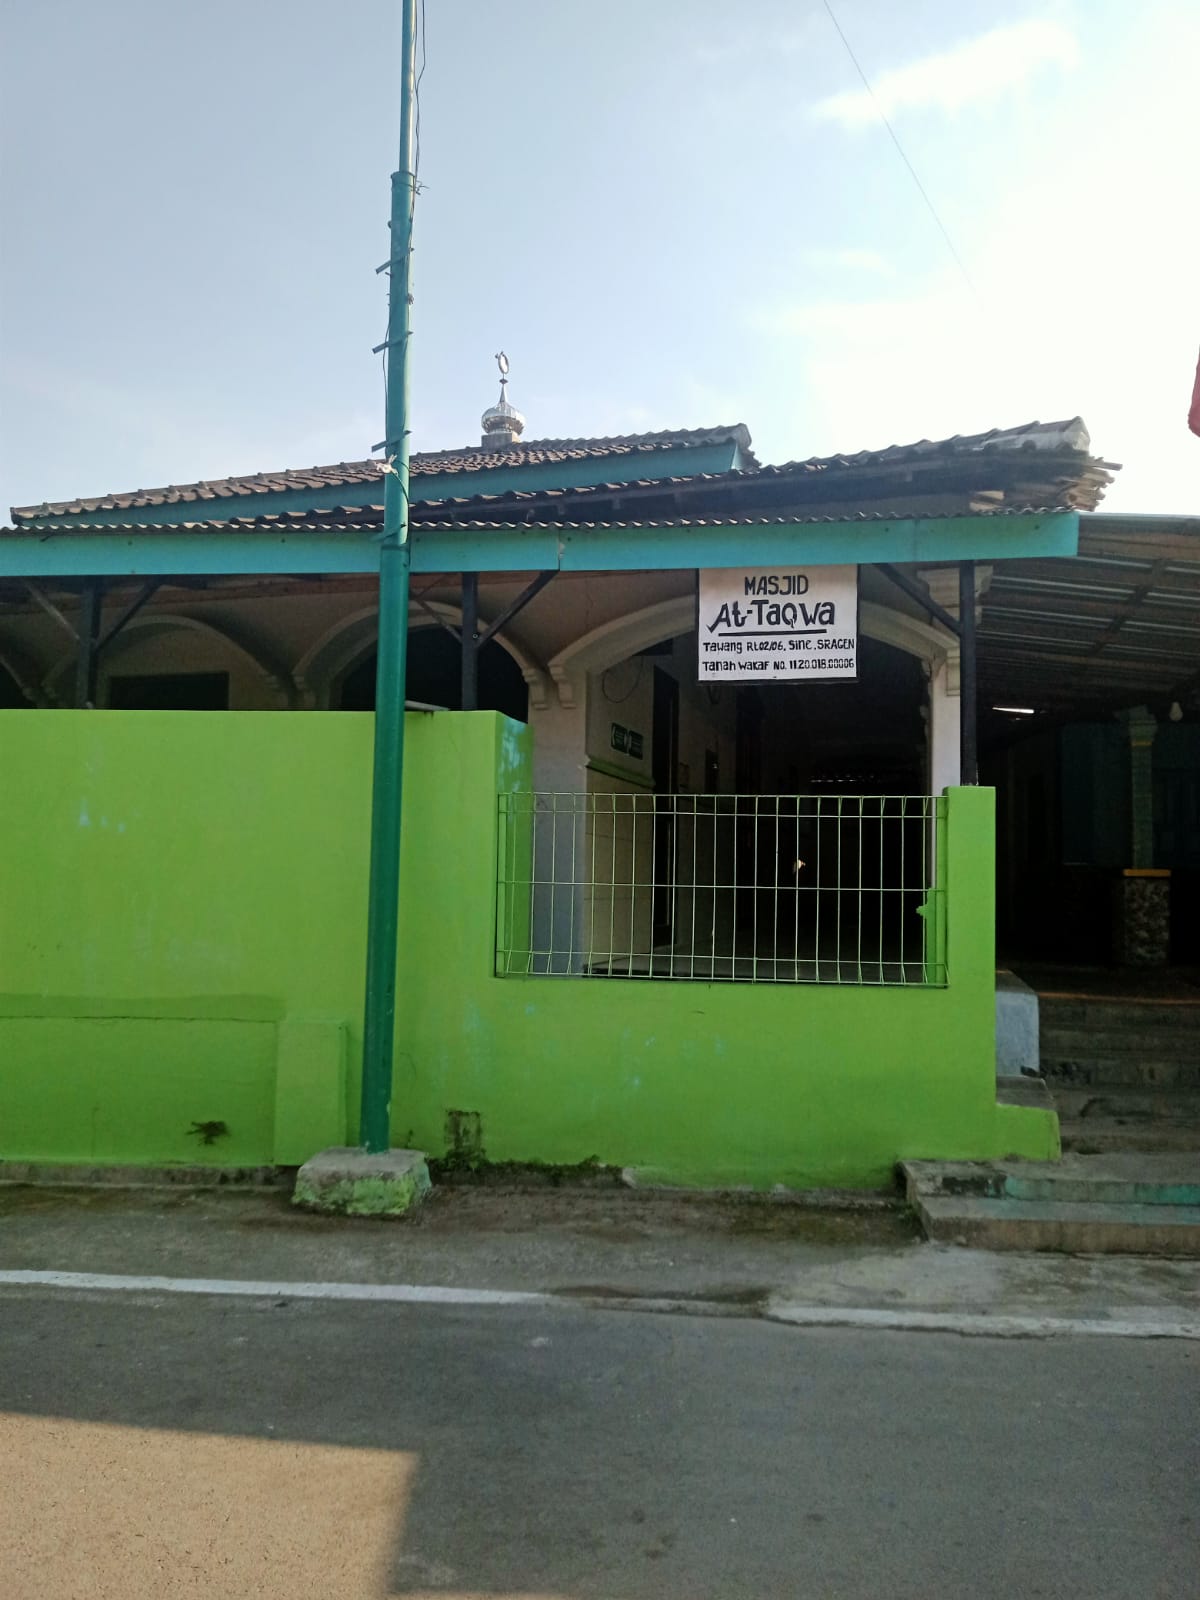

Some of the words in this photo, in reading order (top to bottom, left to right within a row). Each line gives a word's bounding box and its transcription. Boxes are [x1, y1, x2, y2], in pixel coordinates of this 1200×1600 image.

[744, 575, 808, 595] MASJID
[702, 641, 742, 653] Tawang
[702, 660, 736, 671] Tanah
